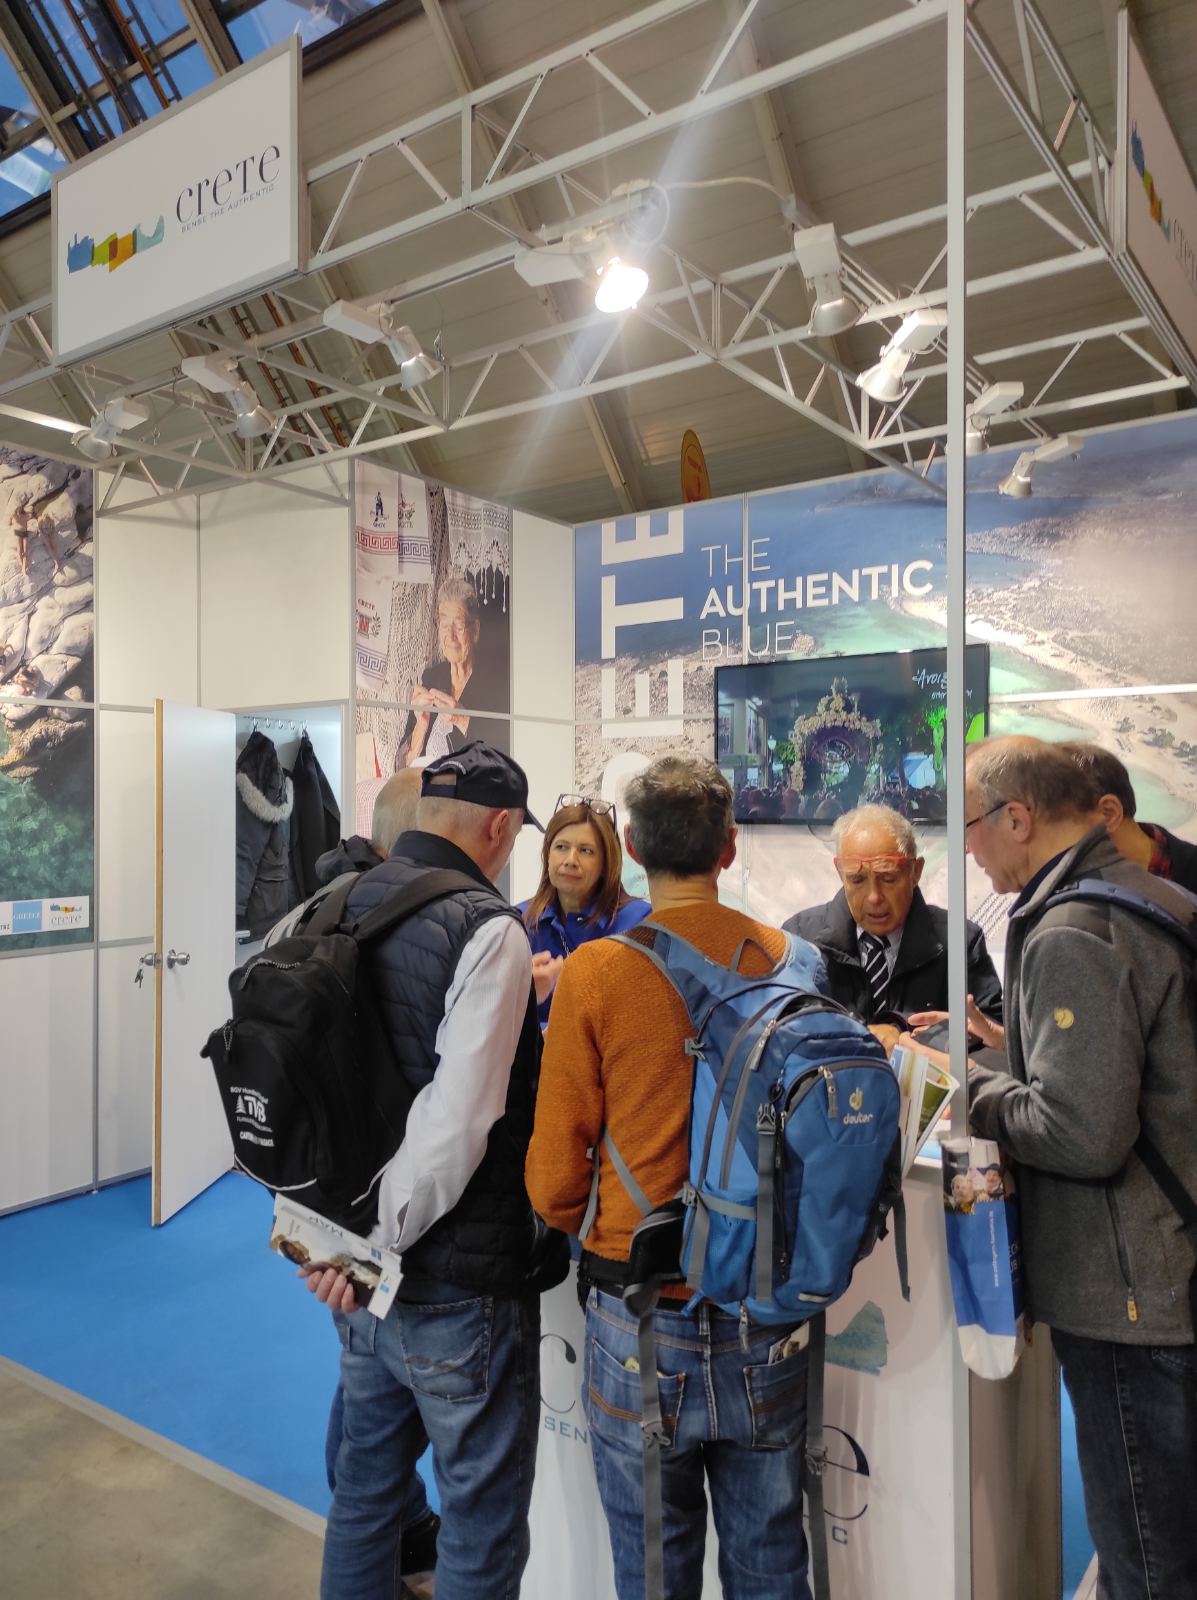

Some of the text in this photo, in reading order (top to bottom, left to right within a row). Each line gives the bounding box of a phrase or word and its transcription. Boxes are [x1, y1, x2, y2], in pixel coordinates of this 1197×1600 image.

[210, 207, 225, 217] THE
[227, 183, 274, 211] AUTHENTIC
[700, 537, 771, 578] THE
[700, 559, 934, 620] AUTHENTIC
[701, 620, 796, 662] BLUE
[243, 1095, 267, 1123] TVB
[843, 1112, 874, 1126] deuter
[544, 1415, 588, 1444] SEN
